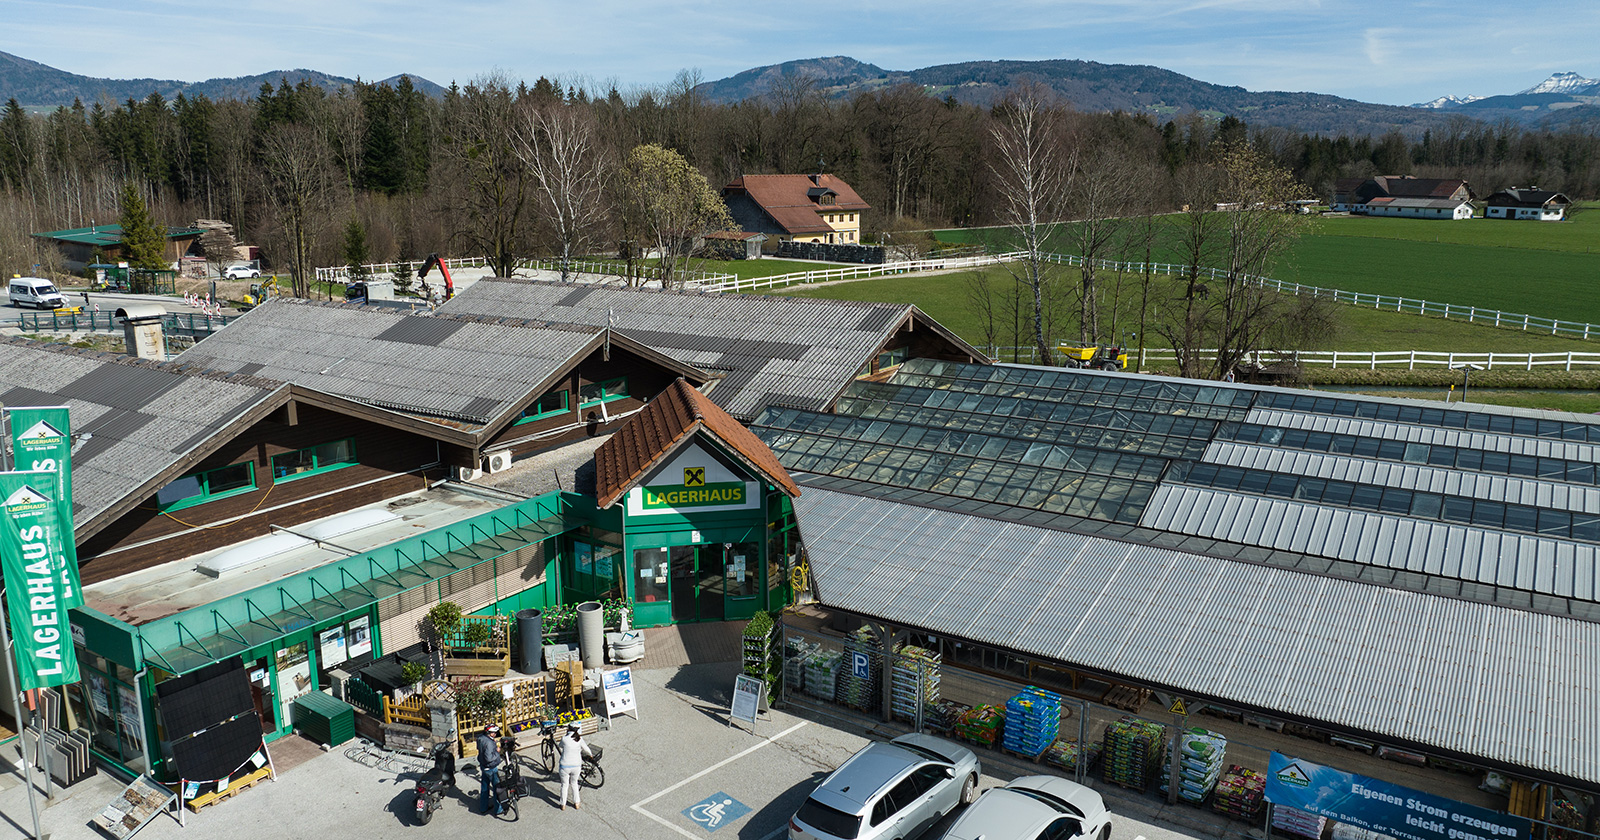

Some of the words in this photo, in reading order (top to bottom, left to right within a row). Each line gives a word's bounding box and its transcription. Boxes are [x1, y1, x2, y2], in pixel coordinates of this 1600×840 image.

[23, 438, 60, 446] LAGERHAUS
[647, 488, 742, 505] LAGERHAUS
[8, 503, 46, 512] LAGERHAUS
[20, 525, 62, 676] LAGERHAUS
[854, 654, 867, 674] P
[1277, 775, 1308, 786] LAGERHAUS
[1304, 803, 1318, 813] Auf
[1320, 808, 1338, 819] dem
[1340, 813, 1371, 828] Balkon,
[1373, 823, 1387, 832] der
[1351, 783, 1403, 806] Eigenen
[1406, 798, 1448, 819] Strom
[1451, 812, 1518, 838] erzeugen
[1405, 814, 1445, 834] leicht
